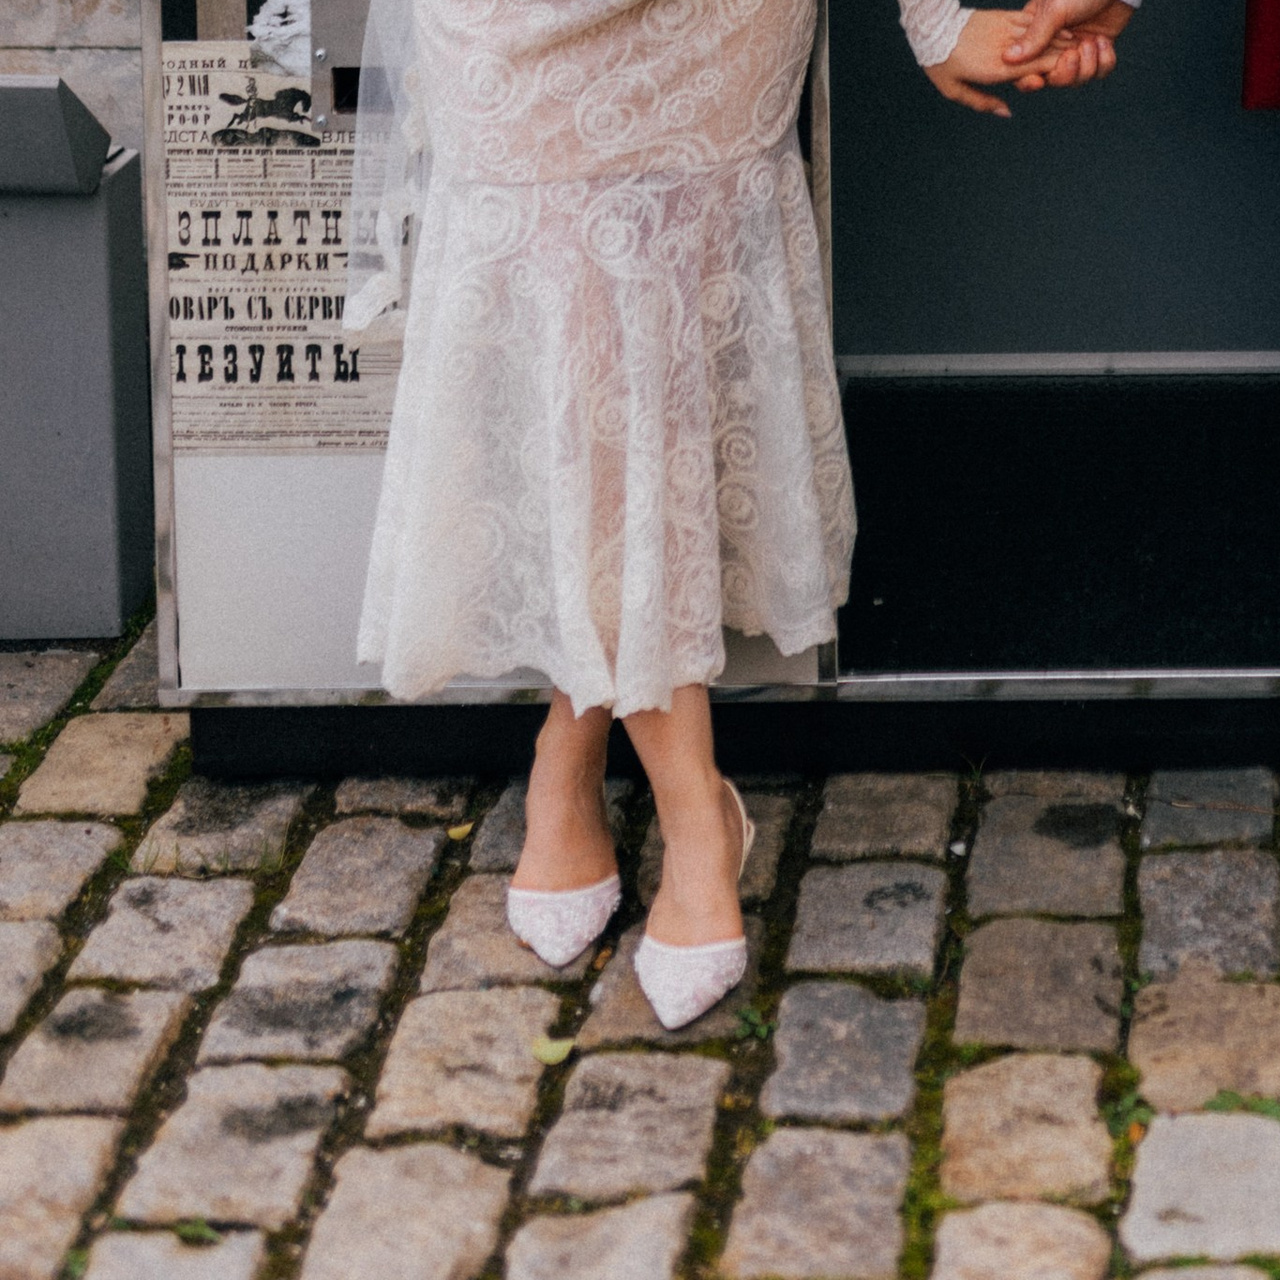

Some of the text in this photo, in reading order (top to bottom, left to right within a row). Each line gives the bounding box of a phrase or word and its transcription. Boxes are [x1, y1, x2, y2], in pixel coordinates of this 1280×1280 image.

[163, 129, 210, 143] ДСТА
[204, 251, 330, 276] ПОДАРКИ
[246, 295, 273, 321] СЪ
